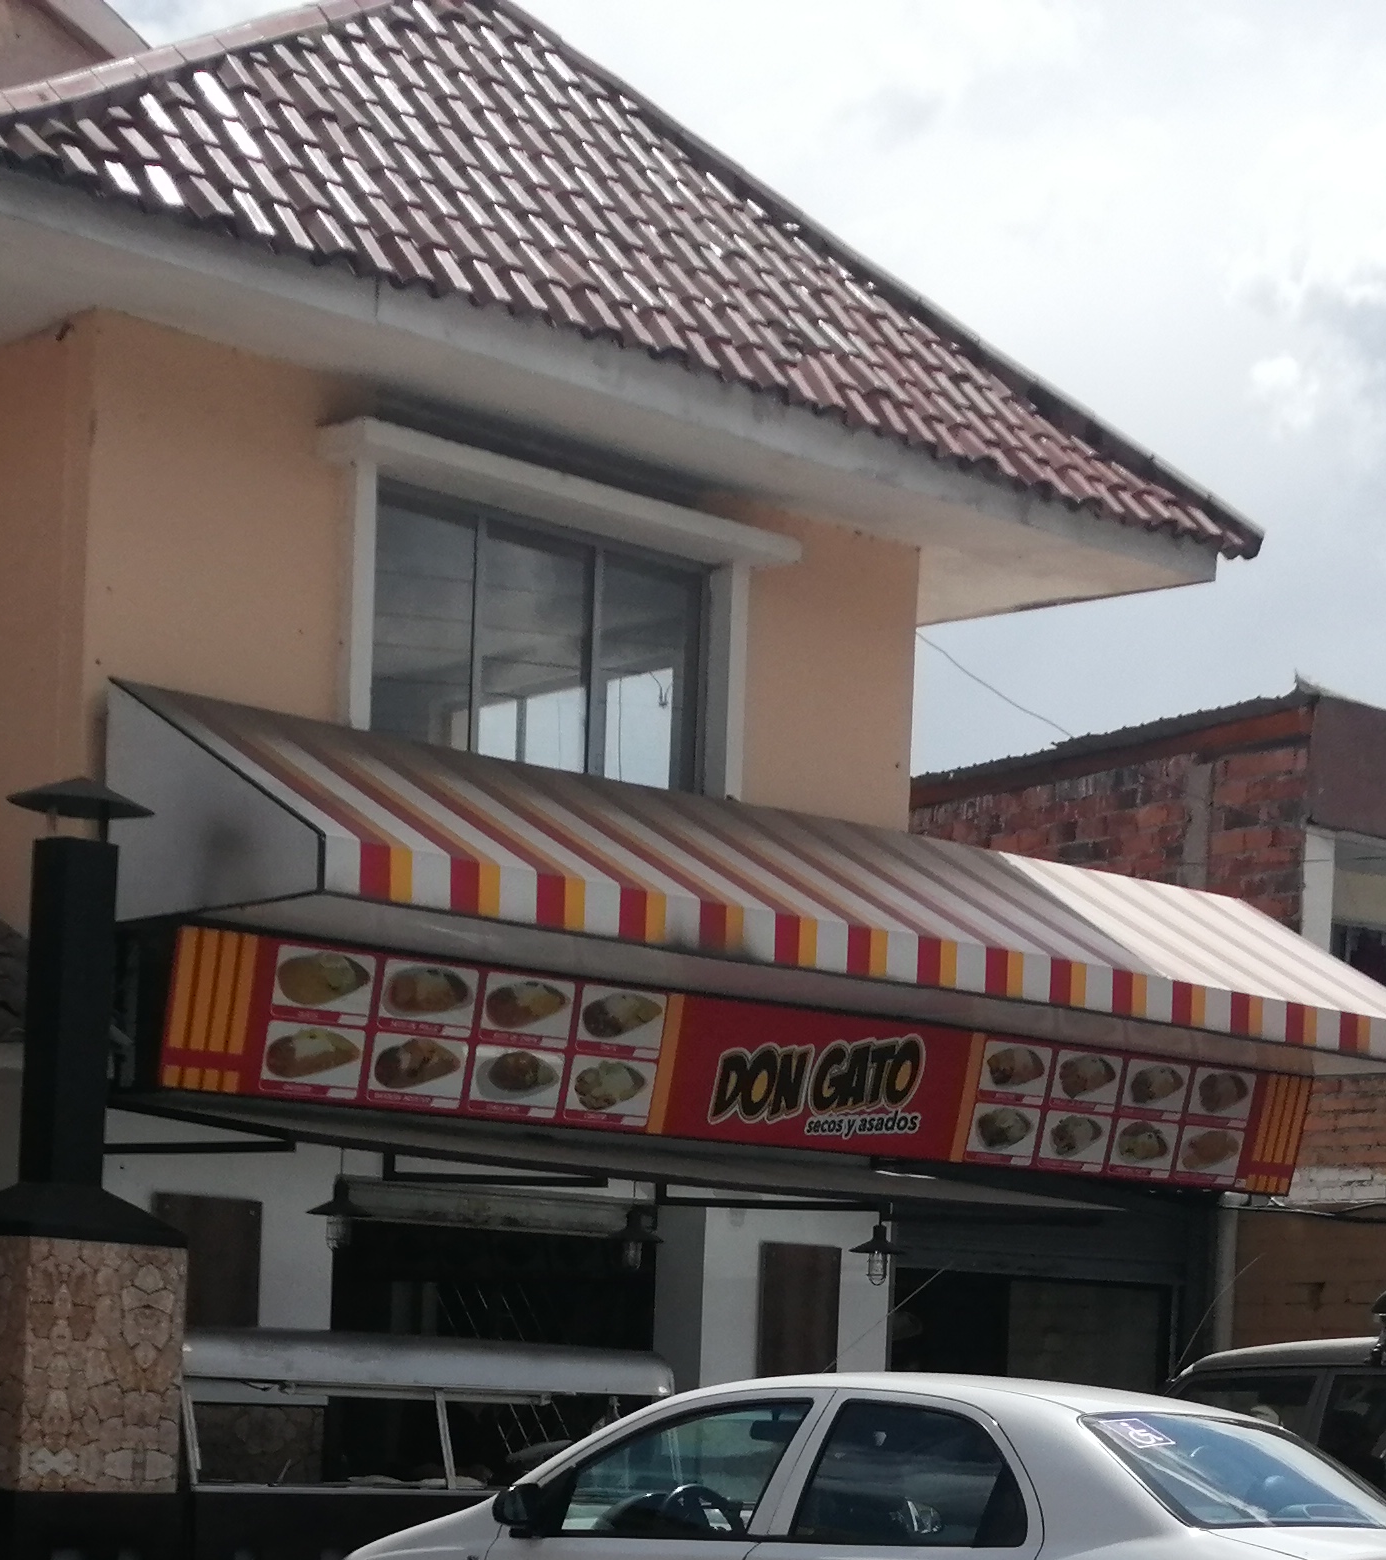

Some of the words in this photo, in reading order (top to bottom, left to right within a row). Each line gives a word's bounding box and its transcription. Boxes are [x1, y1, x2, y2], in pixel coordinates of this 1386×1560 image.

[710, 1045, 814, 1123] DON
[810, 1036, 925, 1115] GATO
[806, 1118, 843, 1134] secos
[845, 1118, 855, 1138] y
[859, 1111, 921, 1132] asados
